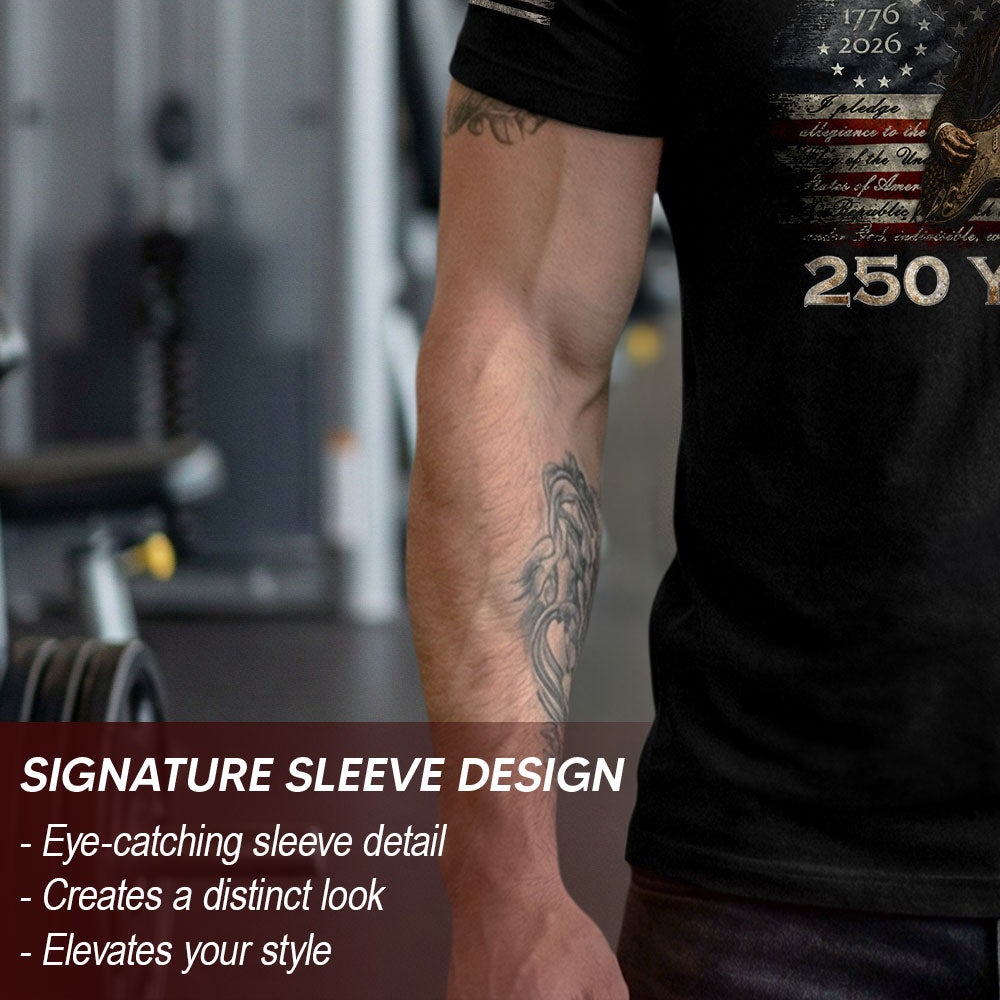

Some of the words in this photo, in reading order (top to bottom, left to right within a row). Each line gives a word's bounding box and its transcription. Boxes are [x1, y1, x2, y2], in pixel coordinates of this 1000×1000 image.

[842, 2, 901, 31] 1776
[838, 31, 902, 54] 2026
[828, 97, 902, 120] pledge
[799, 121, 879, 143] allegiance
[882, 125, 899, 138] to
[902, 121, 928, 138] the
[845, 148, 869, 171] of
[867, 149, 890, 166] the
[853, 174, 871, 198] of
[803, 254, 951, 308] 250
